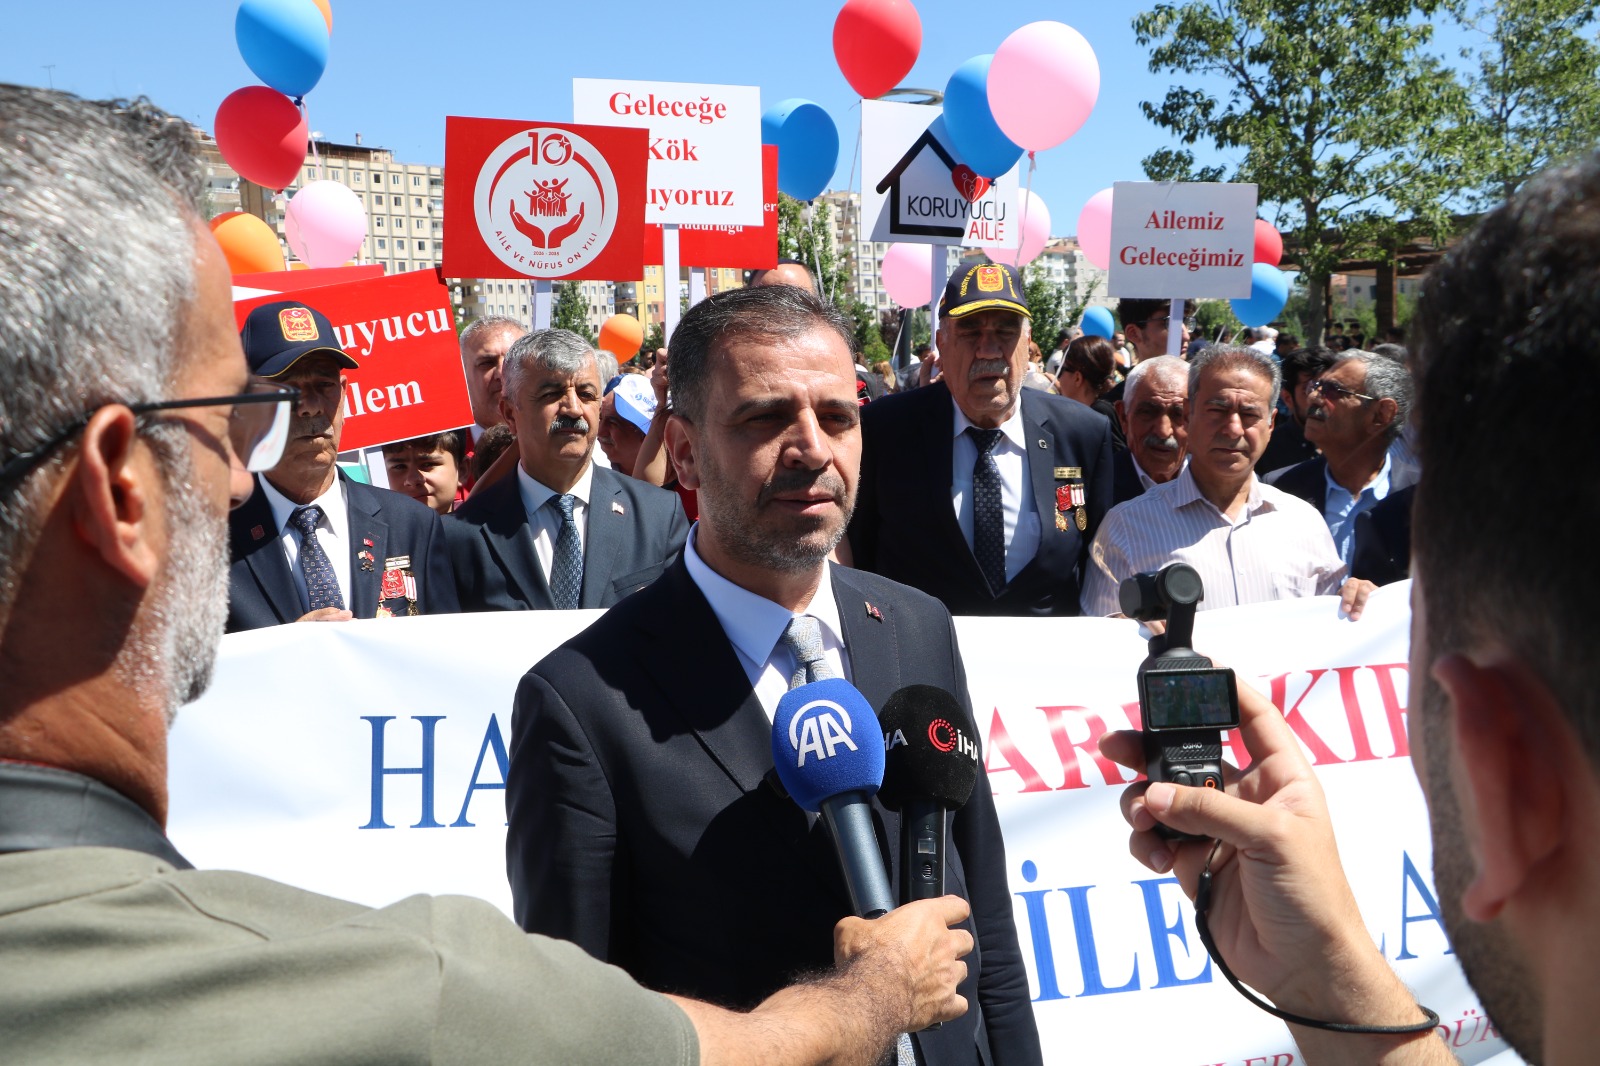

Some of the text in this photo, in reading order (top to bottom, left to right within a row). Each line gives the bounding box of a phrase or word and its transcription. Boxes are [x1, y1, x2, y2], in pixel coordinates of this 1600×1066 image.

[609, 91, 727, 124] Geleceğe
[528, 132, 573, 166] 10
[648, 138, 699, 161] Kök
[646, 188, 734, 211] ıyoruz
[968, 217, 1004, 241] AİLE
[1144, 210, 1225, 231] Ailemiz
[495, 230, 598, 270] AİLE VE NÜFUS ON YILI
[1119, 245, 1245, 272] Geleceğimiz
[796, 711, 859, 768] AA
[957, 728, 979, 765] İHA
[1182, 742, 1203, 750] OSMO
